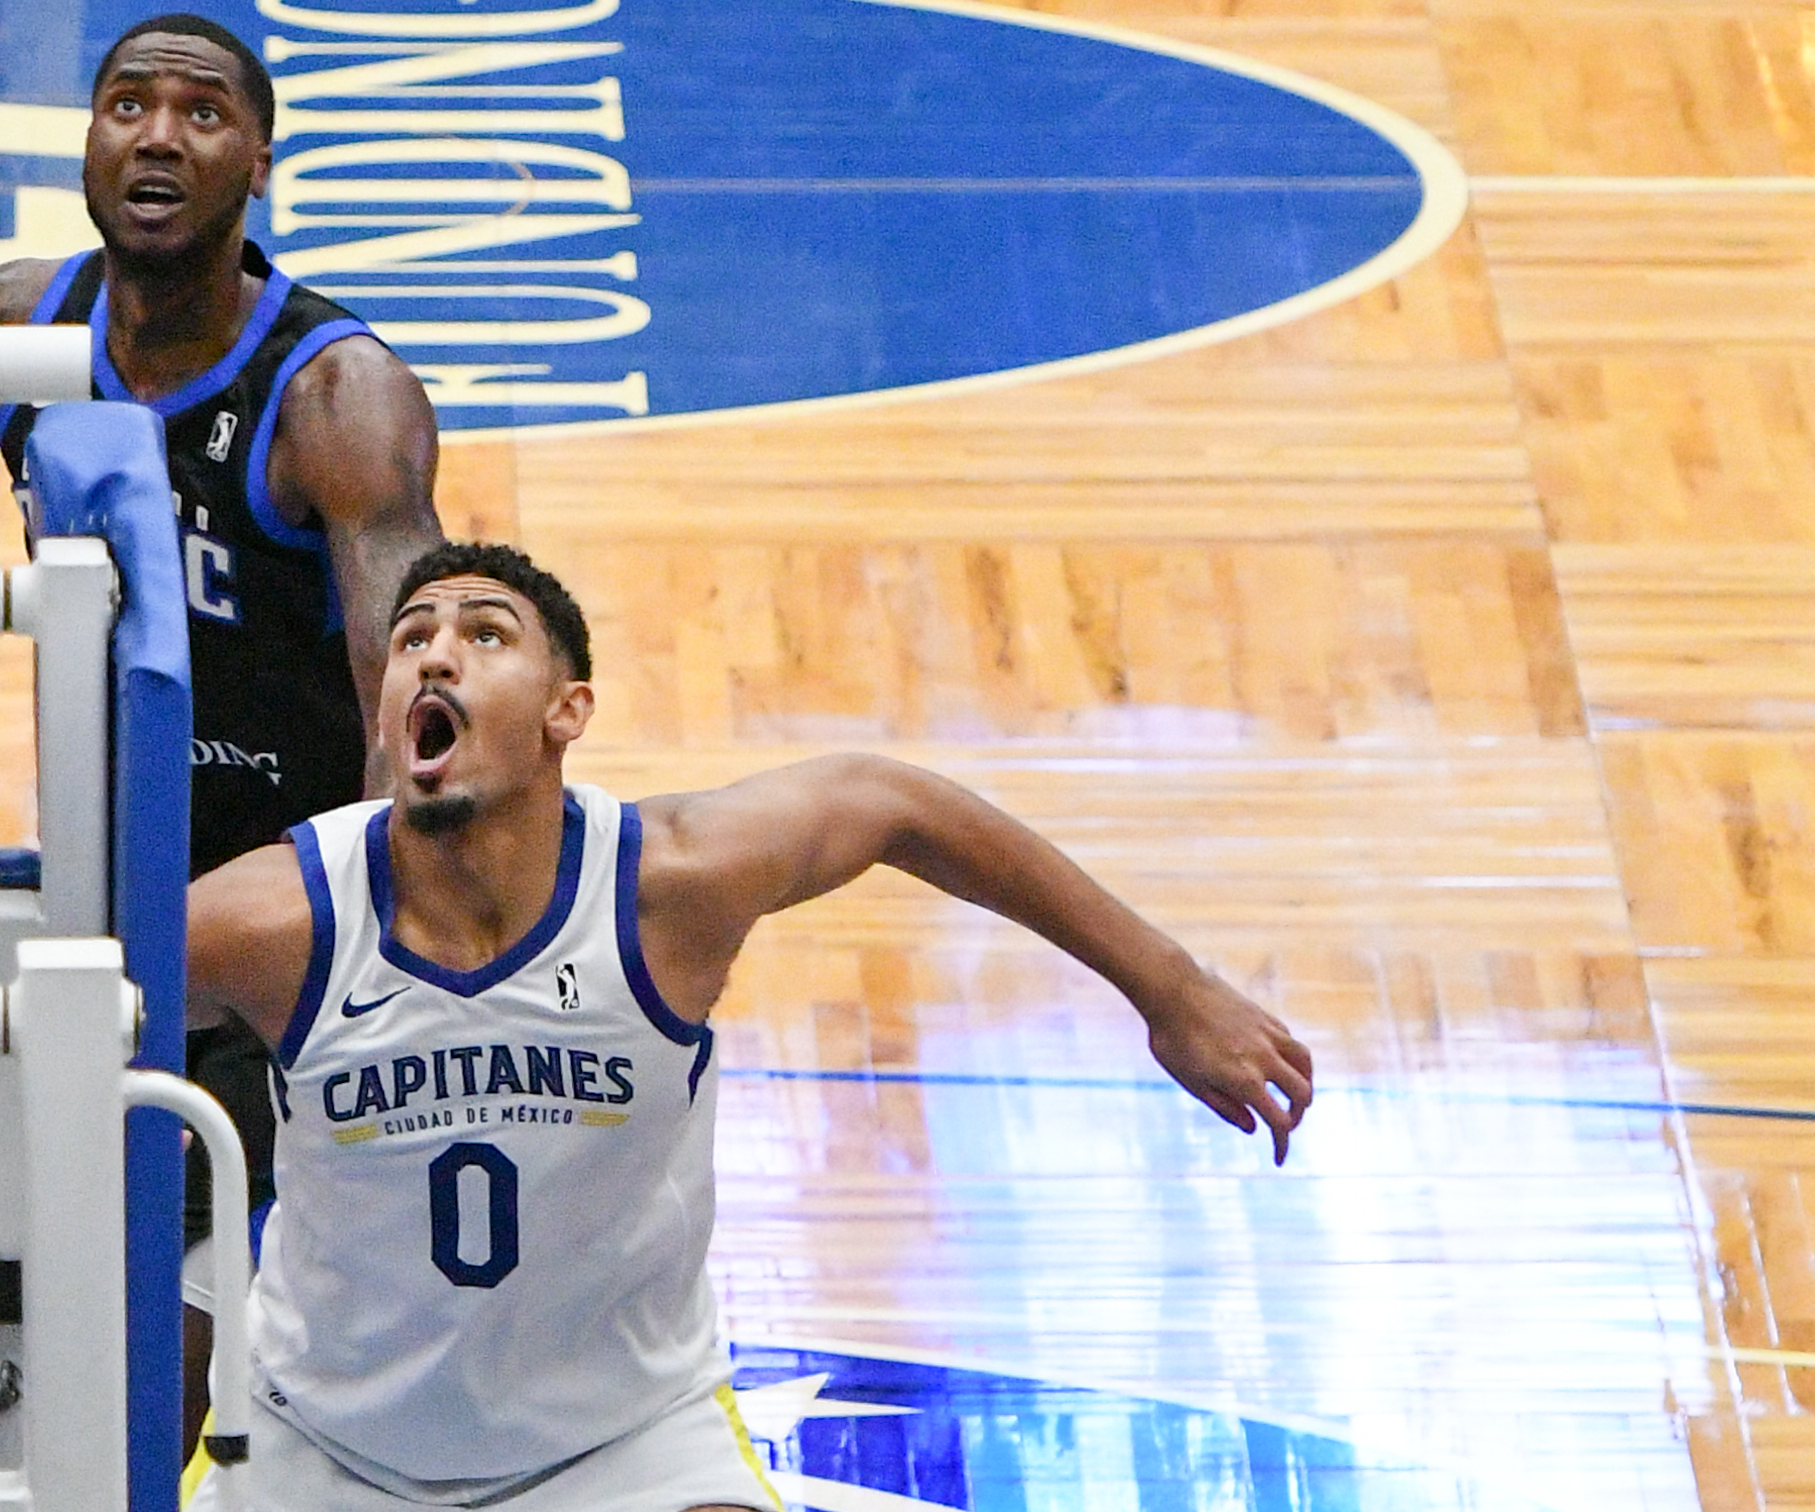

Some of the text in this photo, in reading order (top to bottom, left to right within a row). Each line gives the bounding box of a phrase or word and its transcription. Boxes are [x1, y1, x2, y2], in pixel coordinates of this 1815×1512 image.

[323, 1044, 634, 1122] CAPITANES
[385, 1105, 573, 1136] CIUDAD DE MÉXICO
[428, 1142, 519, 1289] 0
